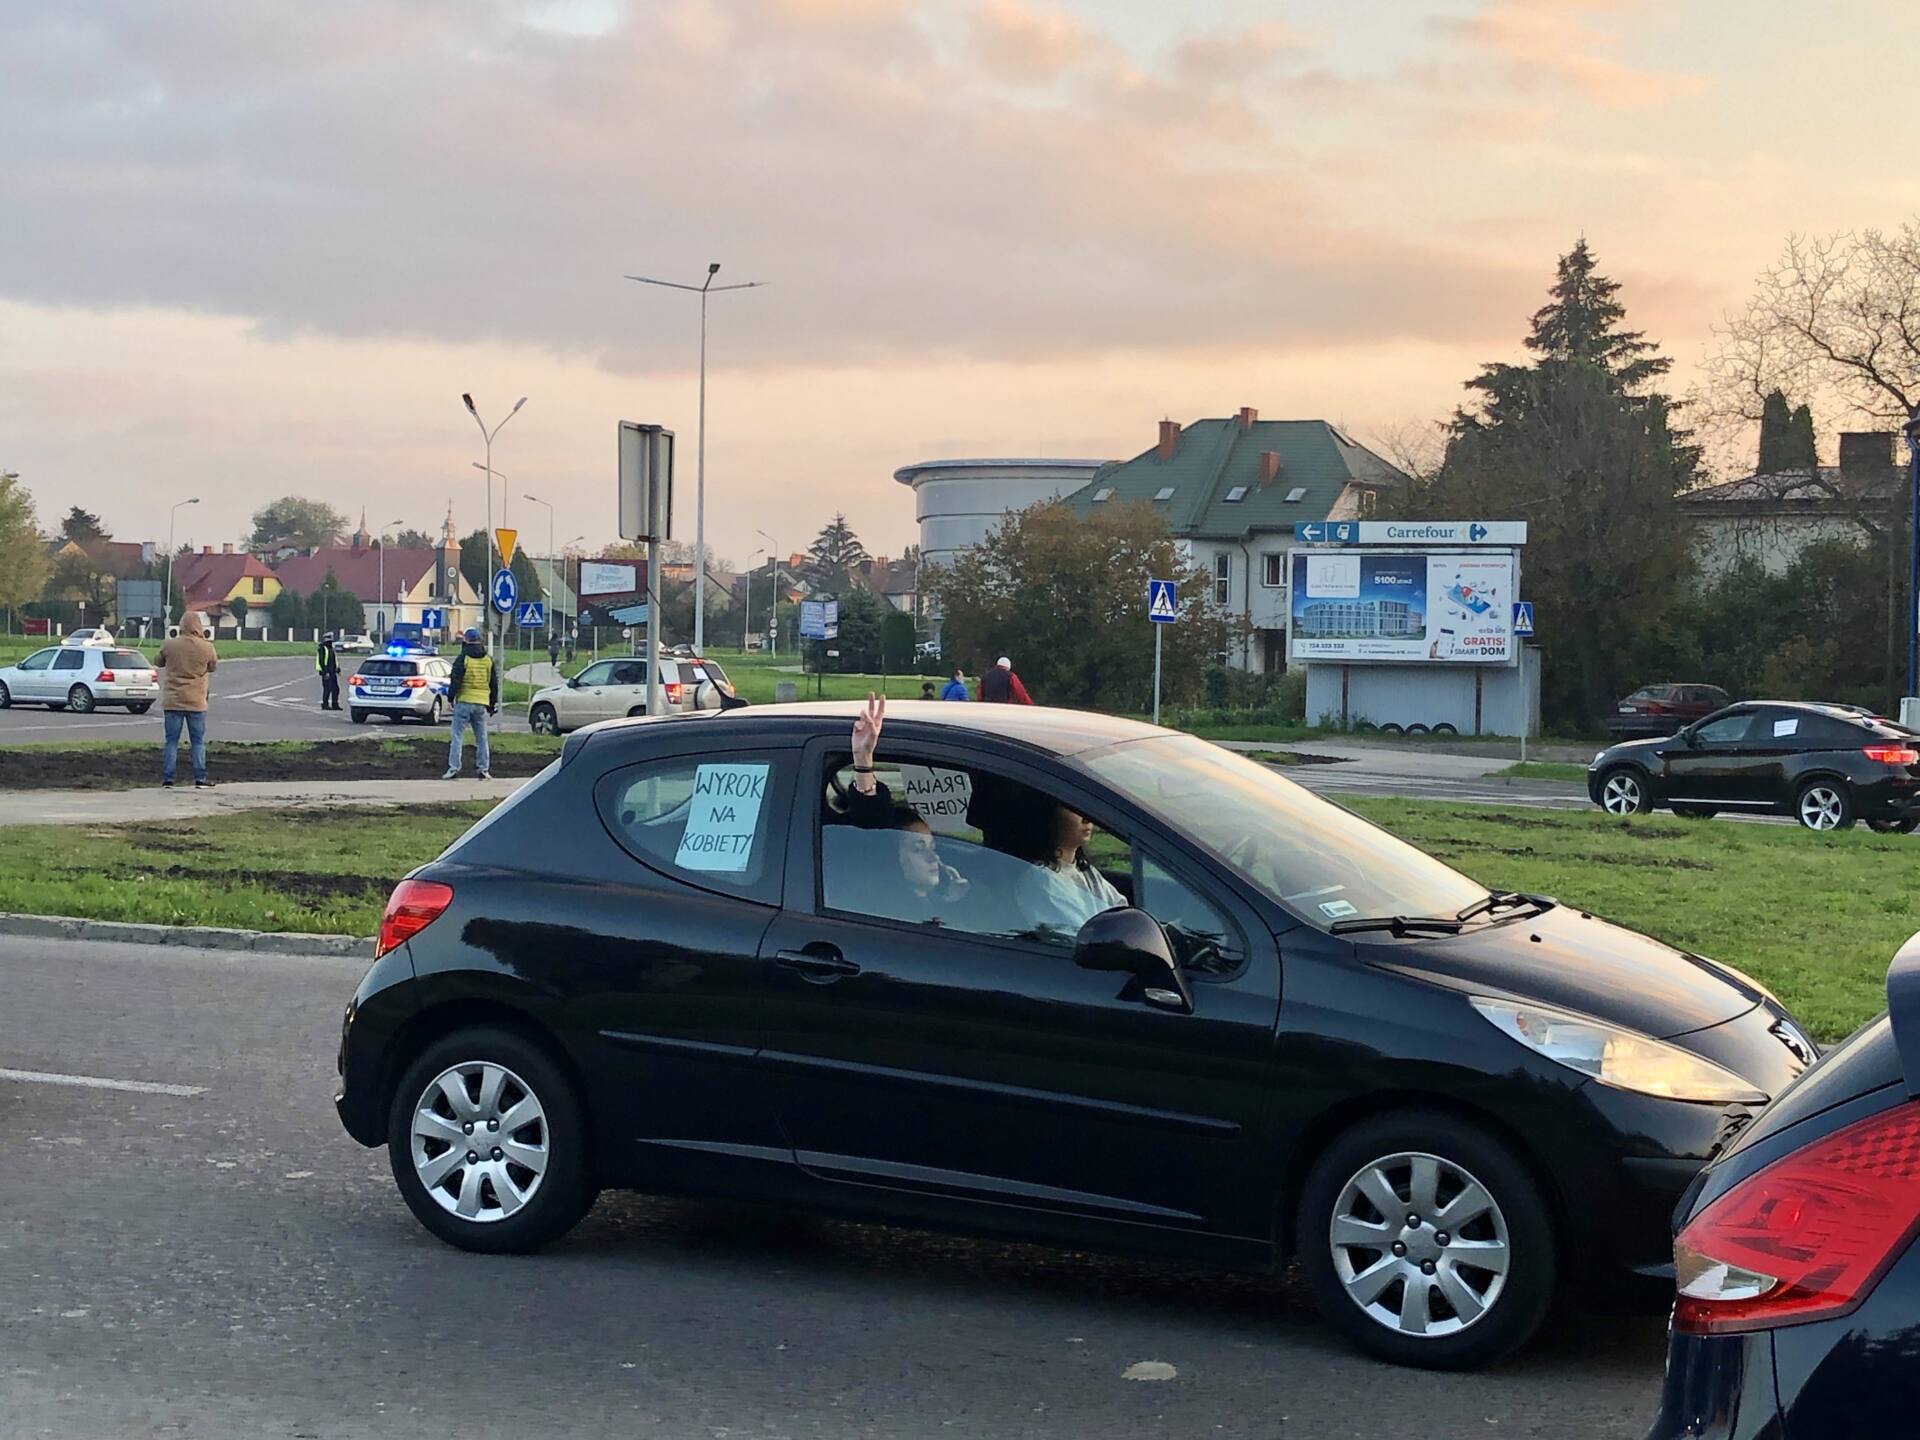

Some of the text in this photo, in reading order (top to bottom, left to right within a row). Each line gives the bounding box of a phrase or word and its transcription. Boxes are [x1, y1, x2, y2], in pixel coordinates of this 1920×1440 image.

[1387, 526, 1454, 538] Carrefour
[1374, 576, 1396, 584] 5100
[1463, 637, 1506, 646] GRATIS!
[1480, 647, 1506, 656] DOM
[695, 771, 766, 799] WYROK
[709, 805, 737, 823] NA
[680, 832, 753, 855] KOBIETY
